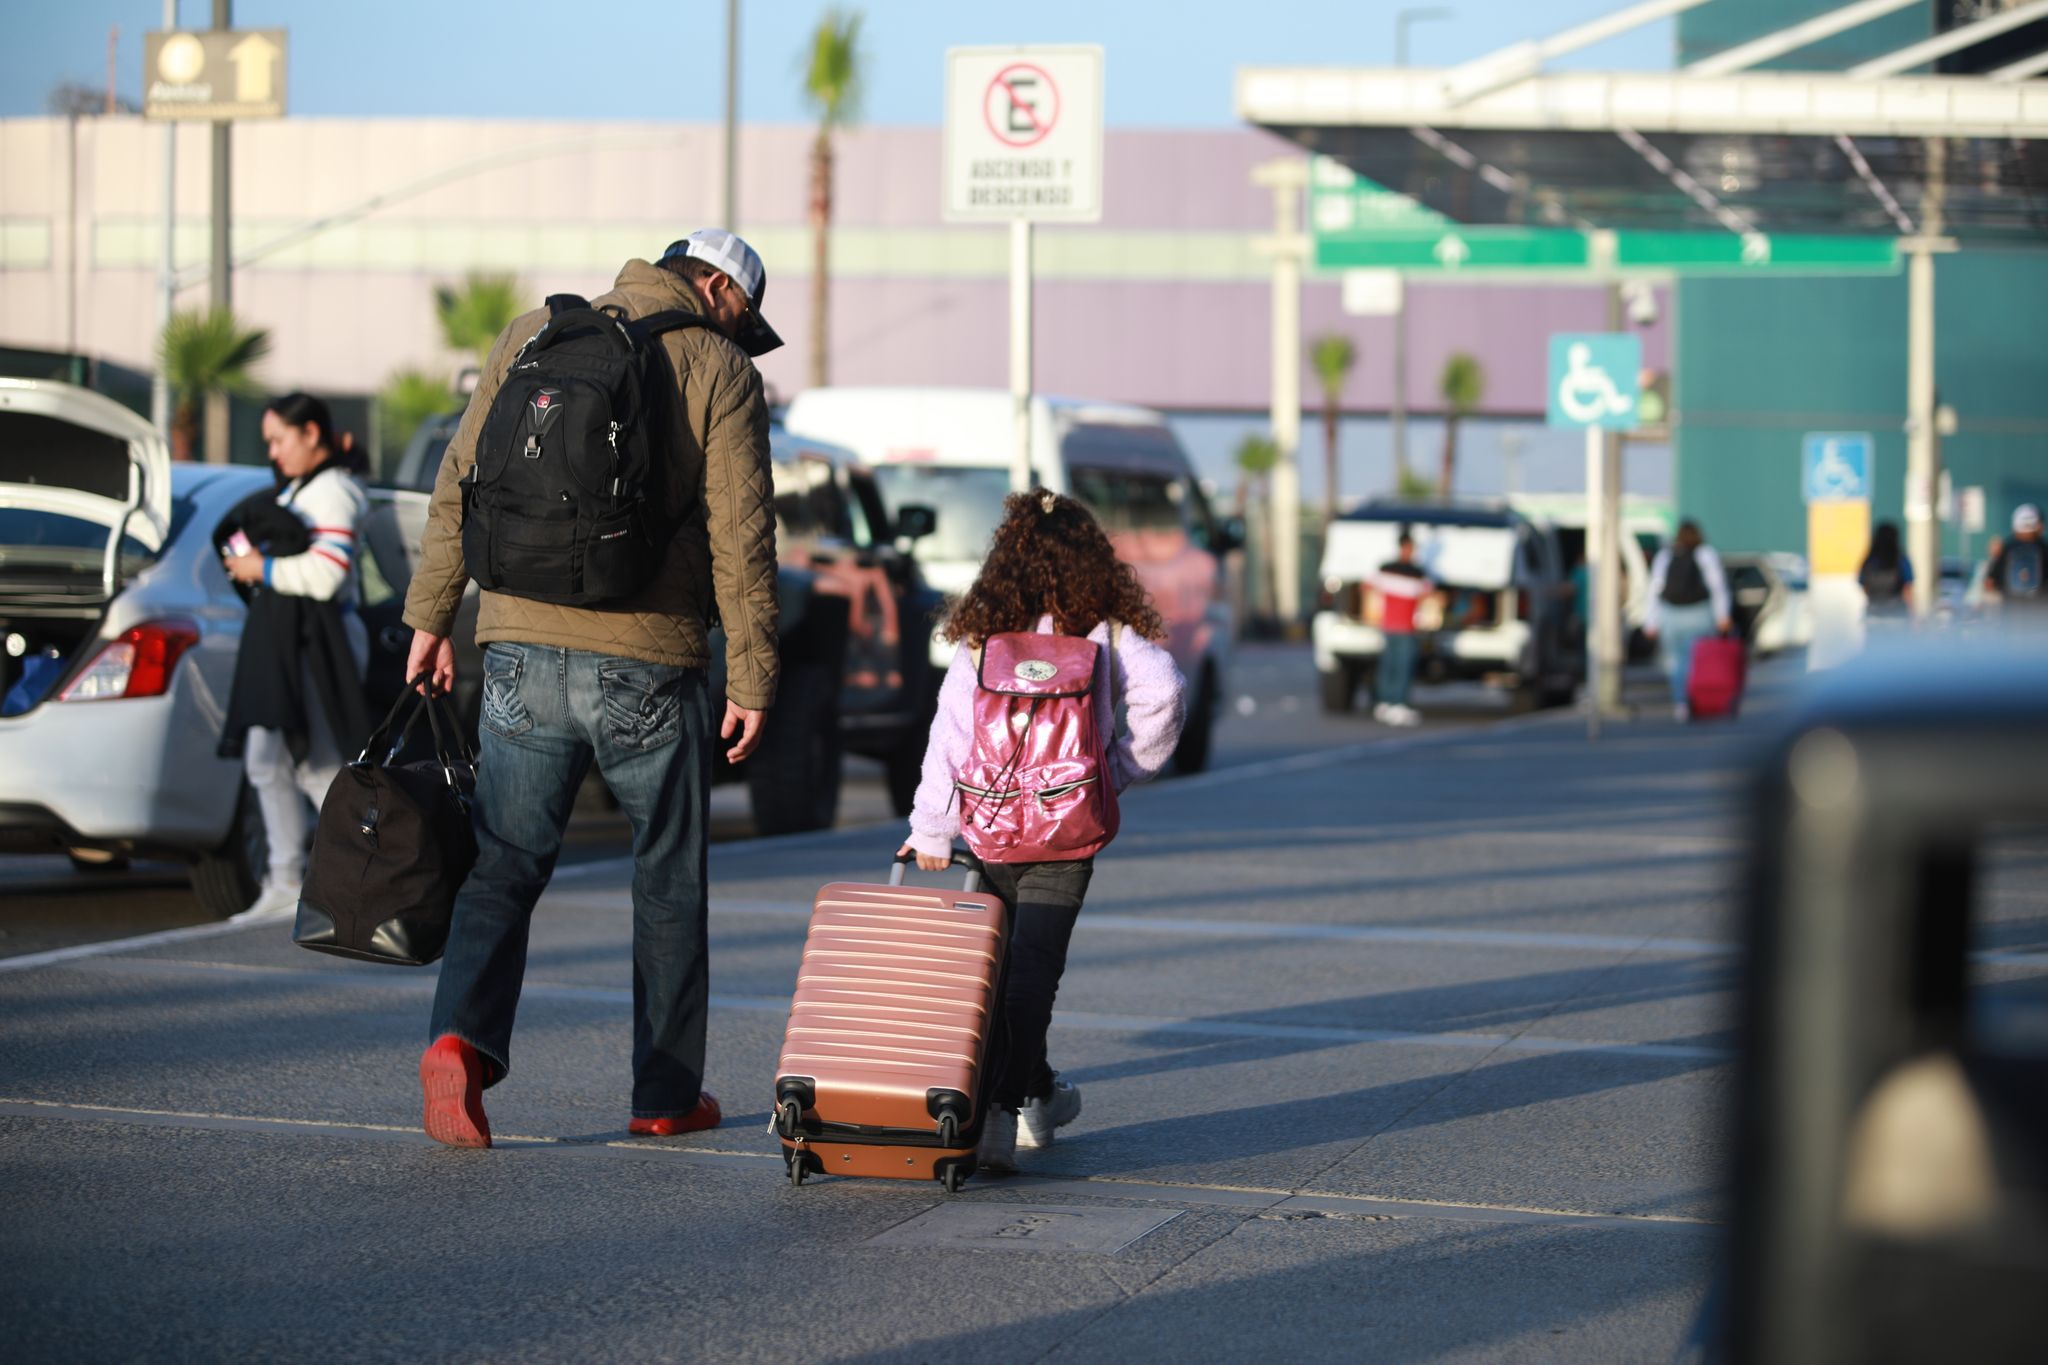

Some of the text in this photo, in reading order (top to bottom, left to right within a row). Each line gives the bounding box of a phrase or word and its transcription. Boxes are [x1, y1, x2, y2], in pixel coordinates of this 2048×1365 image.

[1008, 80, 1036, 131] E
[971, 159, 1054, 177] ASCENSO
[970, 187, 1071, 205] DESCENSO
